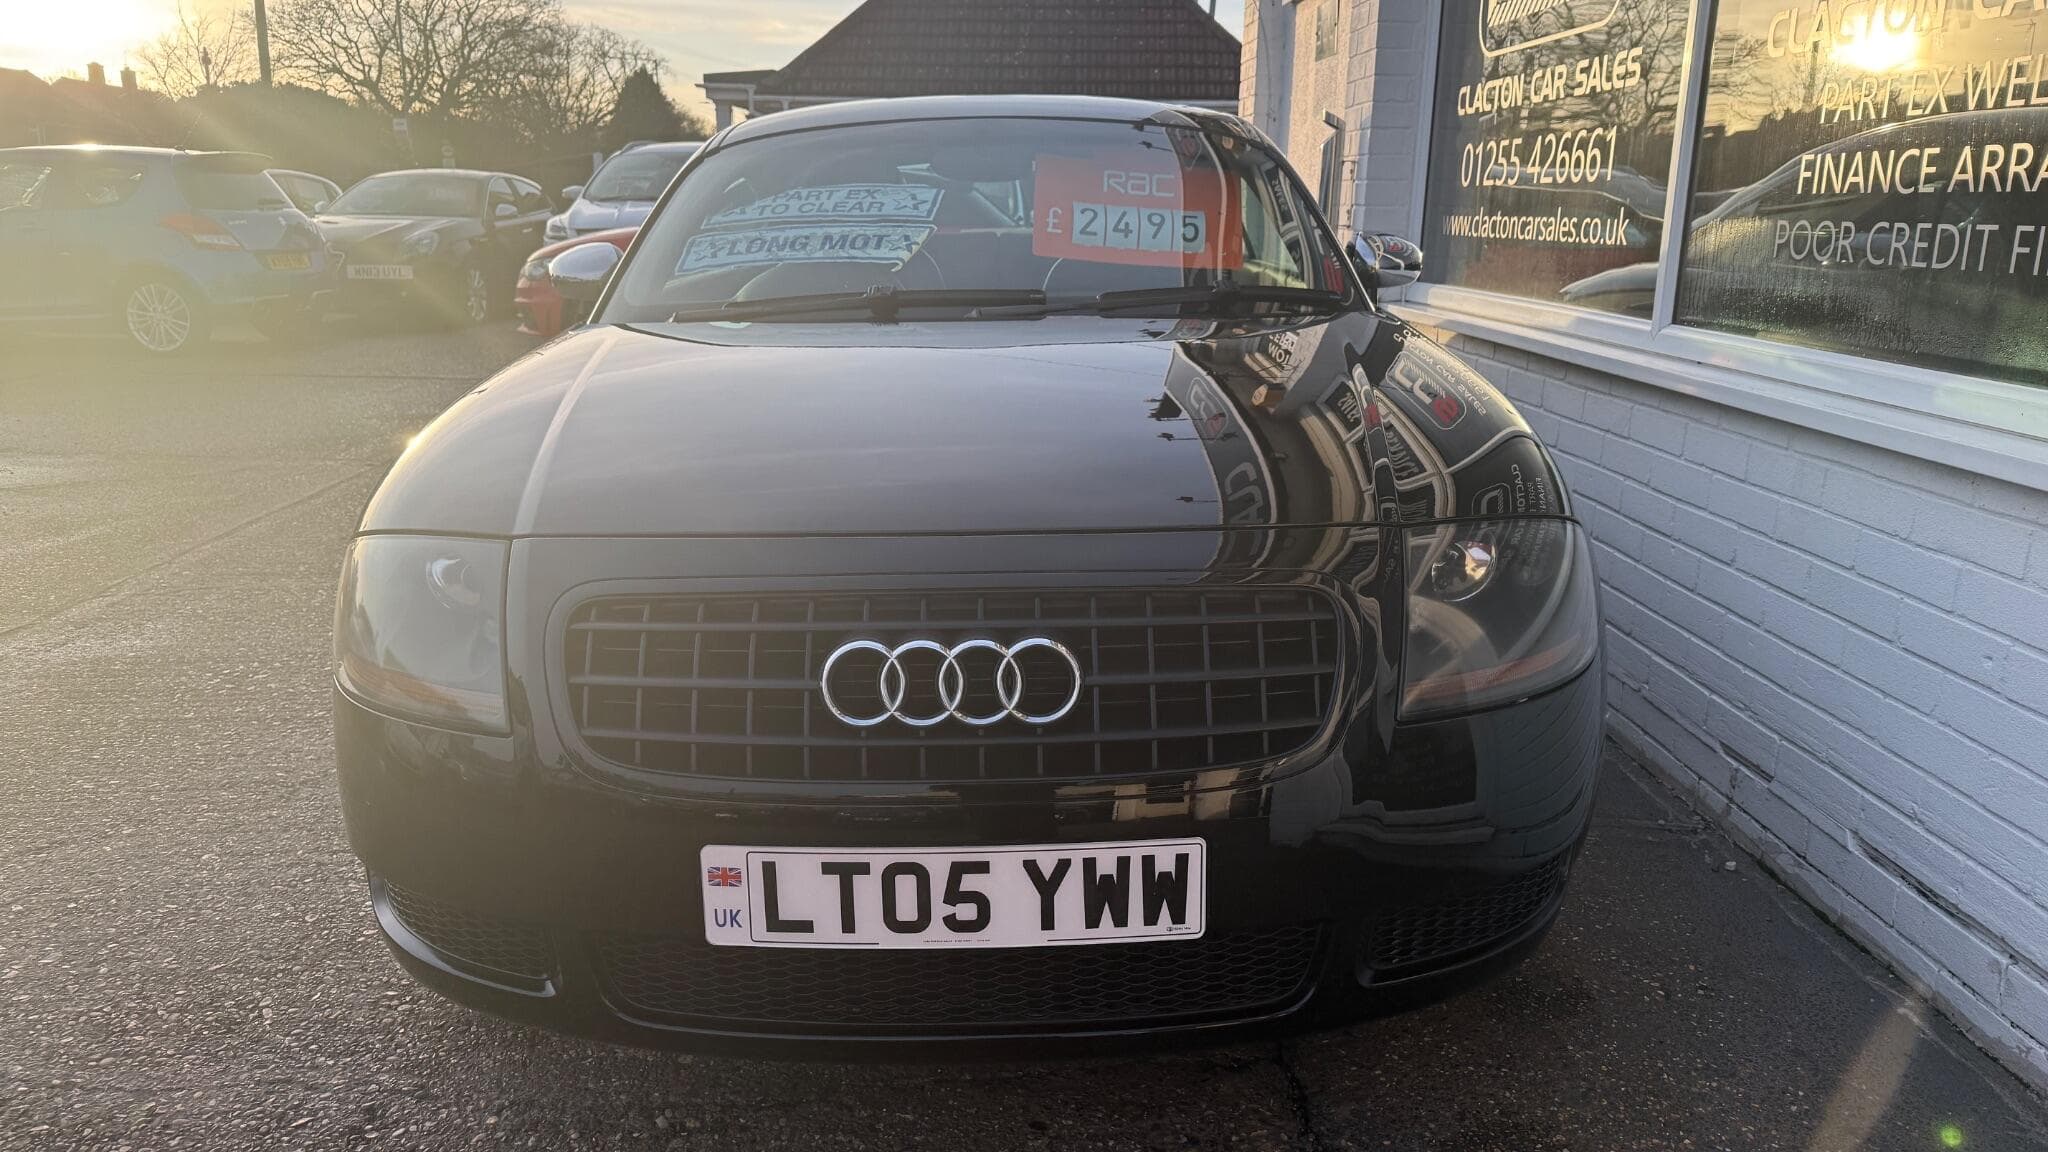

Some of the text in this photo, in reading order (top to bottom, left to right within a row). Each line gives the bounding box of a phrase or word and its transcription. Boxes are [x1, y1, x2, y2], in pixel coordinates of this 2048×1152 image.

[1458, 47, 1643, 116] CLACTON CAR SALES
[1819, 73, 1899, 124] PART
[1907, 65, 1956, 117] EX
[1461, 125, 1618, 188] 01255 426661
[1796, 147, 1941, 195] FINANCE
[758, 201, 886, 217] TO CLEAR
[772, 188, 883, 204] PART EX
[726, 234, 891, 255] LONG MOT
[1442, 206, 1630, 246] www.clactoncarsales.co.uk
[1773, 219, 2048, 277] POOR CREDIT FI
[761, 852, 1191, 935] LT05 YWW
[714, 908, 743, 928] UK
